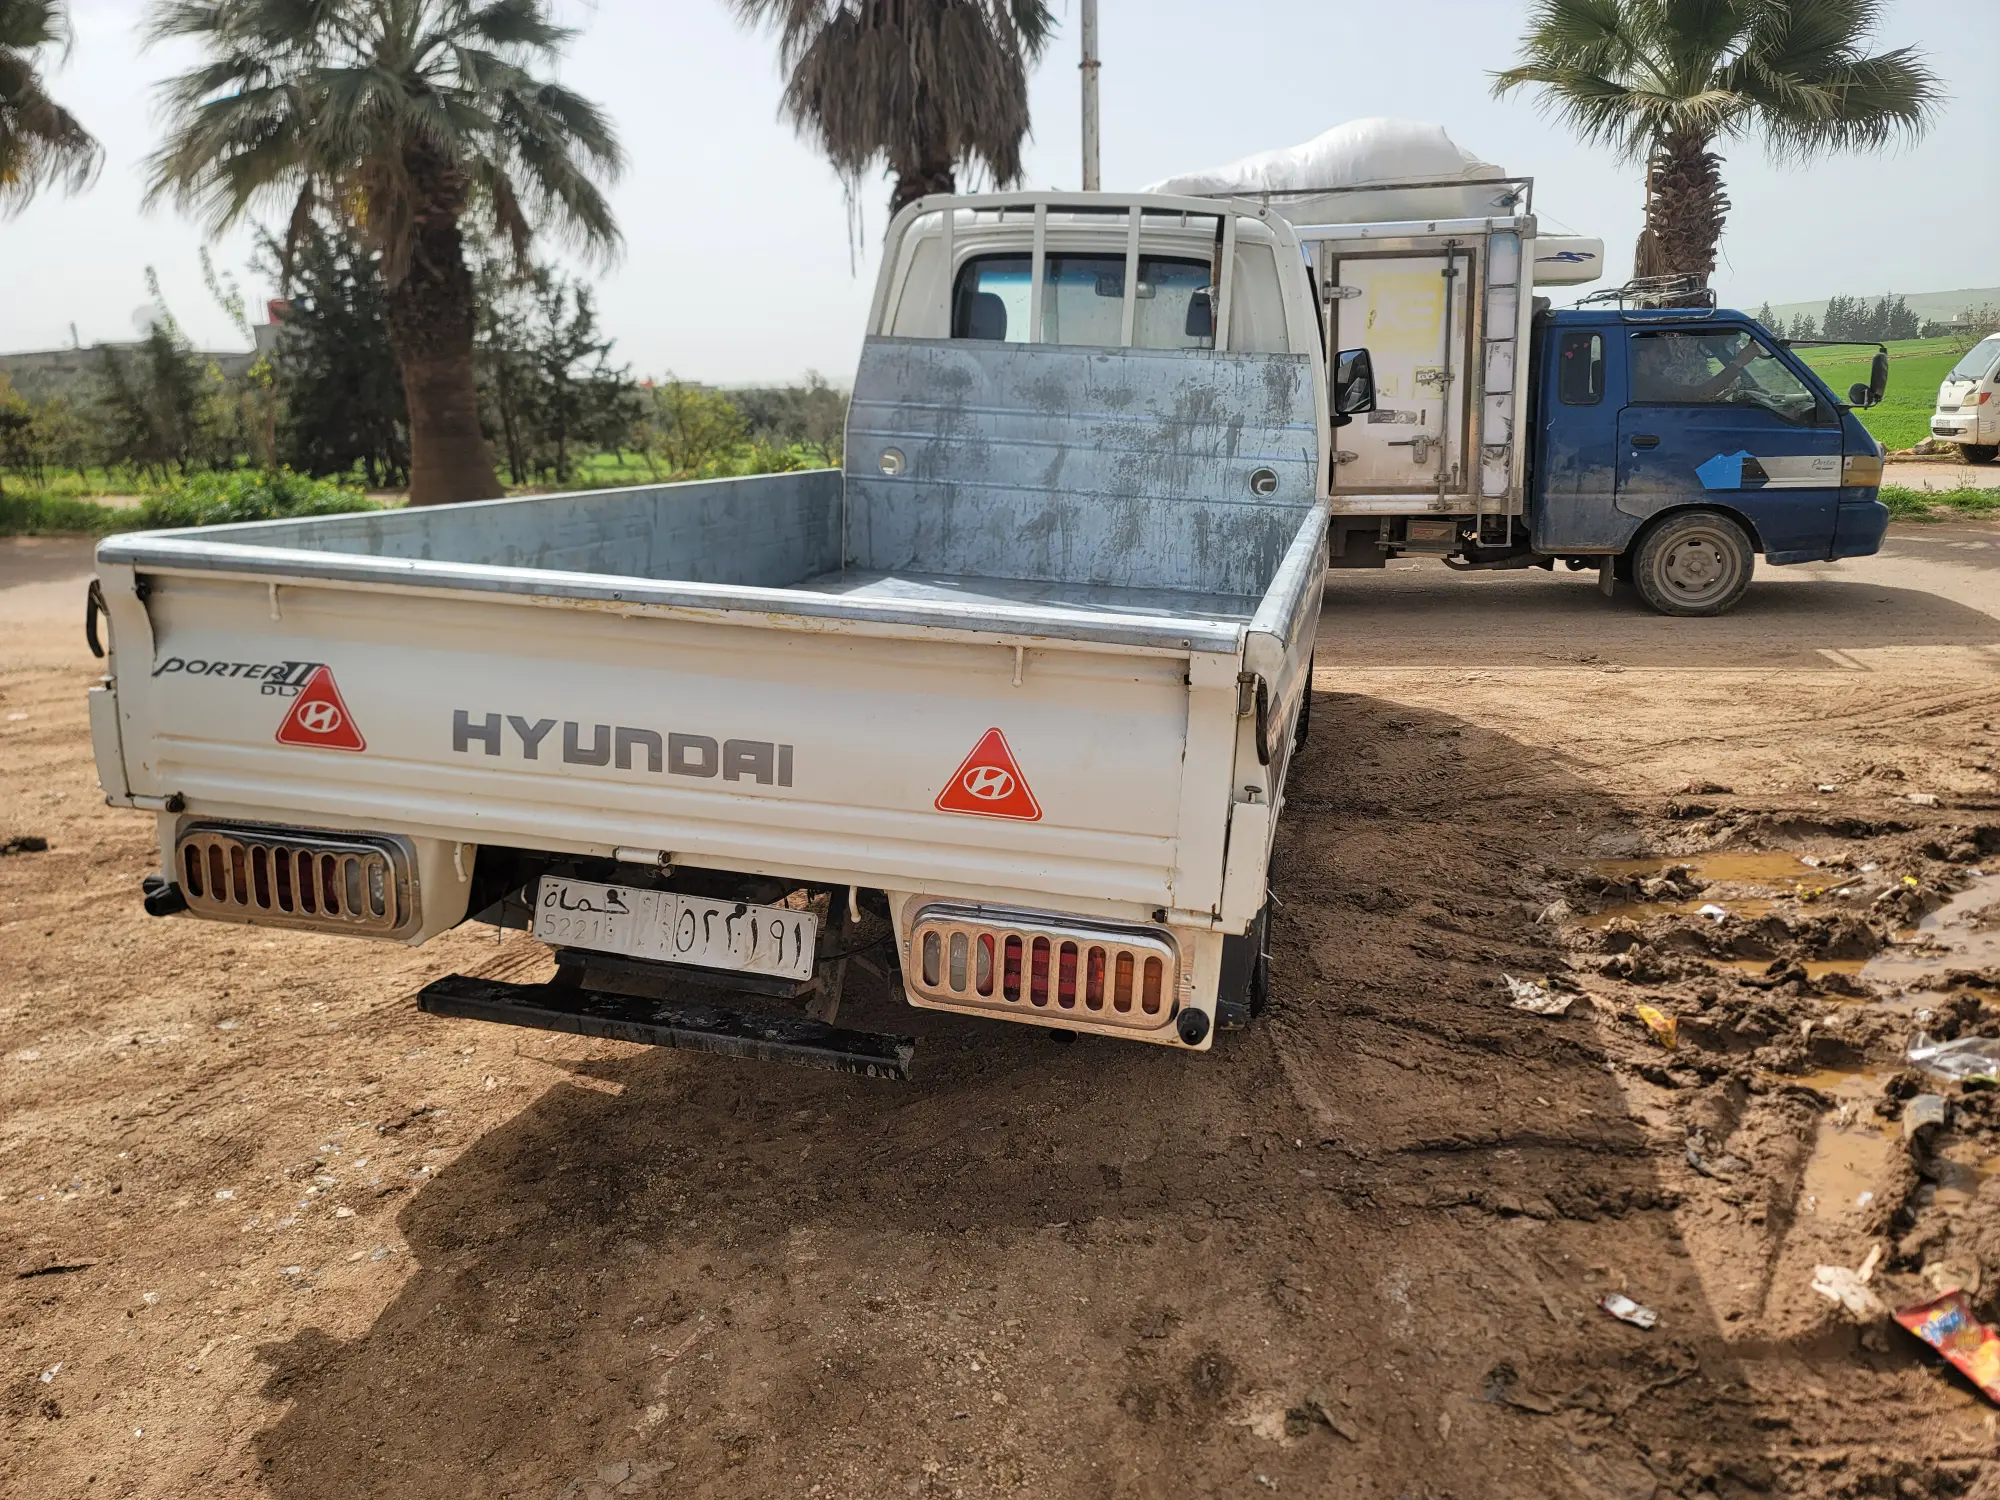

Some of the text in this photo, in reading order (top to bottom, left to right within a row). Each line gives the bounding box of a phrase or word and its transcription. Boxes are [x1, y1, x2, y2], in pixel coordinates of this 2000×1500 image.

[151, 657, 288, 680] PORTER
[453, 709, 794, 788] HYUNDAI
[544, 883, 630, 914] حماة
